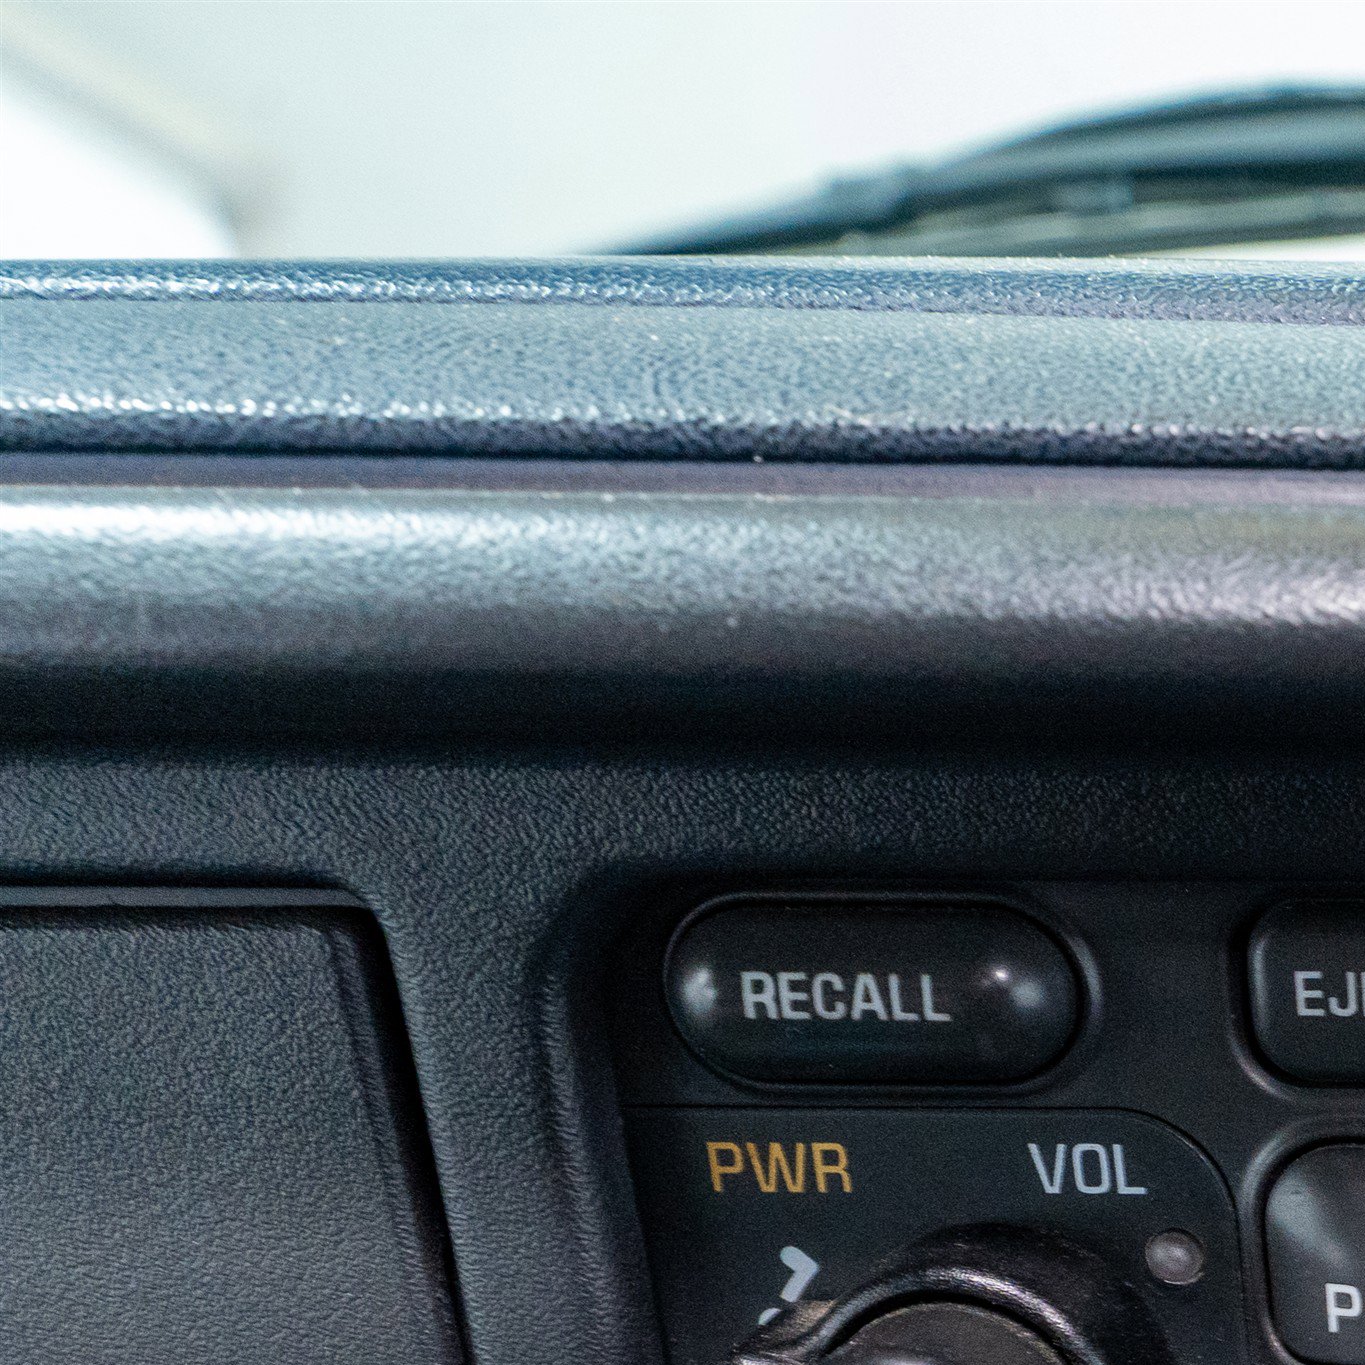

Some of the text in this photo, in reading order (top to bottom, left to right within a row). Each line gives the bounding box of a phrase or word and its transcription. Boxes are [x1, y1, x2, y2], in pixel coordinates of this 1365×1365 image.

[741, 971, 951, 1022] RECALL
[707, 1141, 852, 1193] PWR
[1027, 1142, 1148, 1195] VOL
